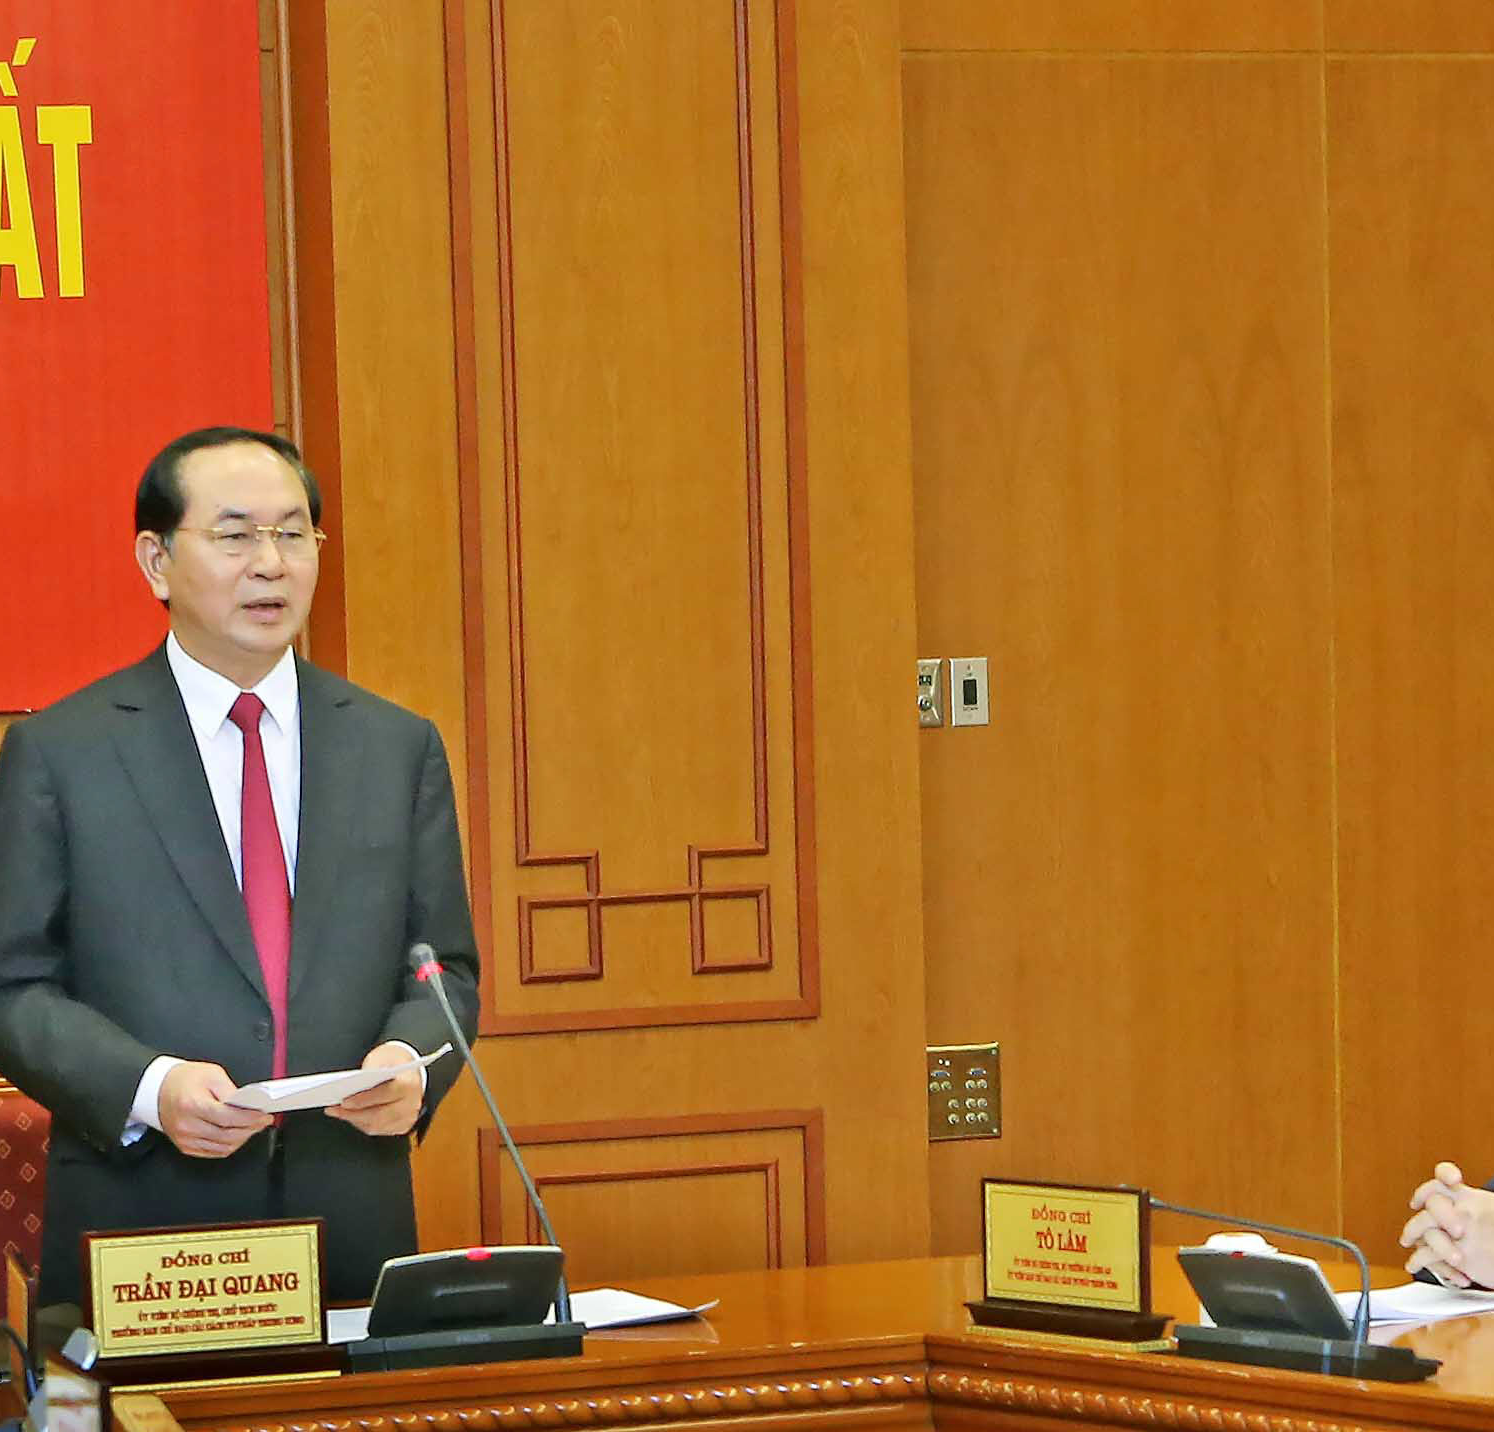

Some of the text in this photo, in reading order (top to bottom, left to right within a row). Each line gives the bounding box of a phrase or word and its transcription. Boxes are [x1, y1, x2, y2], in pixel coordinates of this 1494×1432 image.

[1036, 1227, 1055, 1250] TÔ
[218, 1247, 251, 1264] CHÍ
[113, 1271, 300, 1303] TRẦN ĐẠI QUANG
